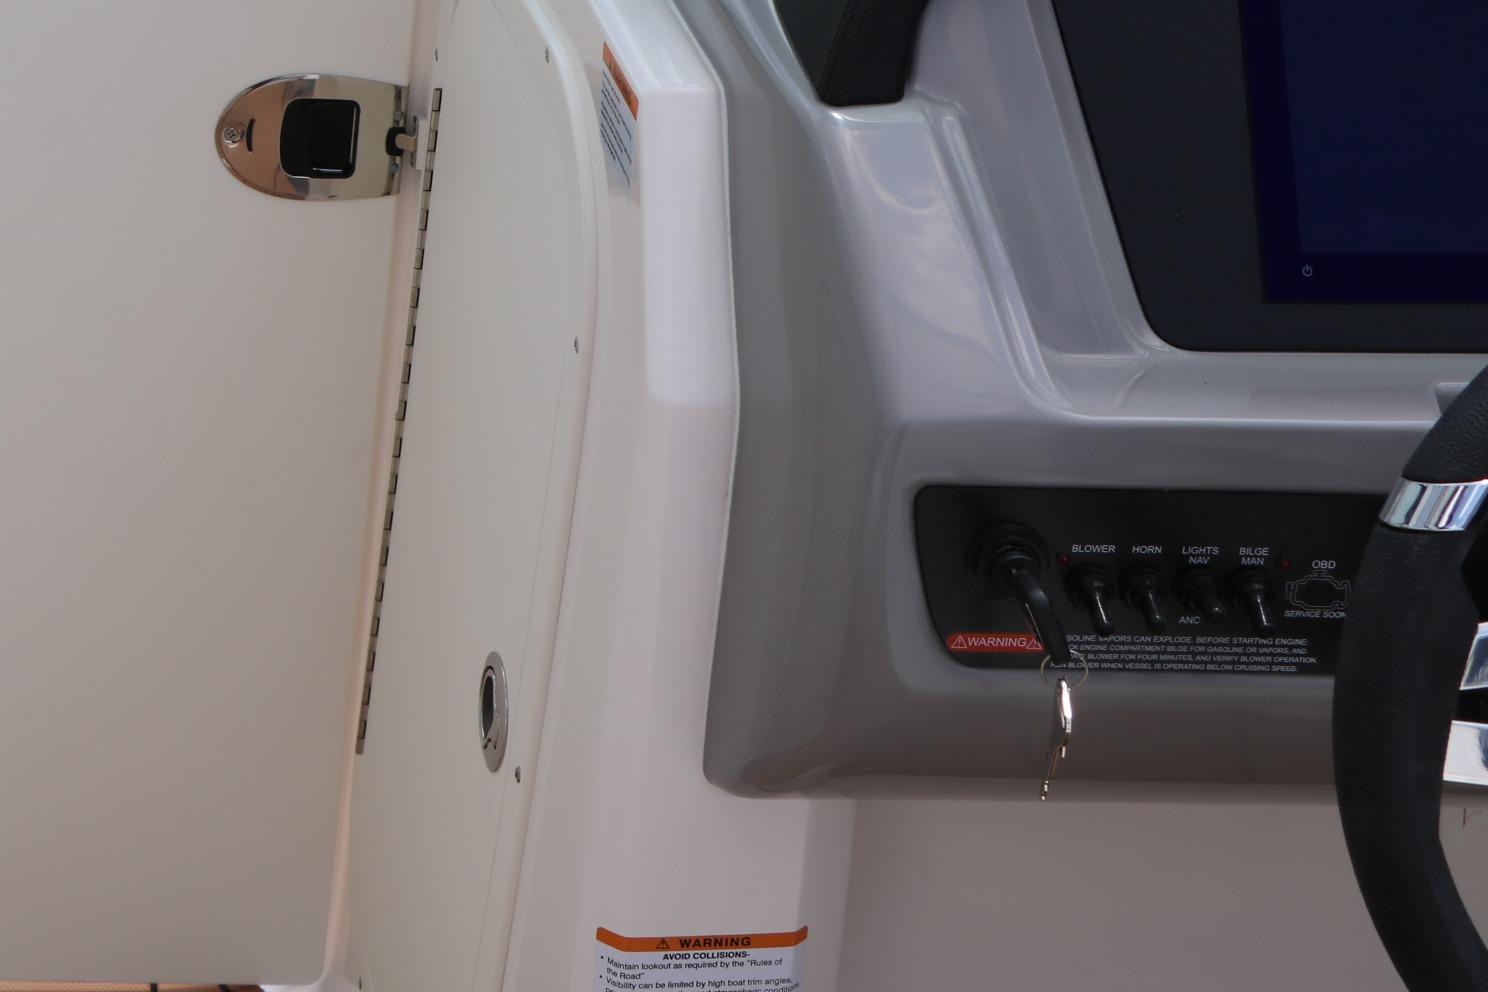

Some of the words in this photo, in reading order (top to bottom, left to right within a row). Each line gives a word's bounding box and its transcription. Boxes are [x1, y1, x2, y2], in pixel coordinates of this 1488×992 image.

[1072, 545, 1116, 553] BLOWER
[1132, 545, 1162, 554] HORN
[1182, 546, 1219, 555] LIGHTS
[1239, 547, 1269, 556] BILGE
[1189, 556, 1210, 565] NAV
[1242, 557, 1264, 565] MAN
[1312, 560, 1335, 569] OBD
[1284, 610, 1321, 618] SERVICE
[1179, 616, 1200, 624] ANC
[968, 637, 1027, 647] WARNING
[1153, 636, 1193, 644] EXPLODE.
[680, 937, 751, 948] WARNING
[663, 952, 690, 961] AVOID
[607, 958, 639, 970] Maintain
[642, 962, 671, 970] lookout
[685, 961, 718, 970] required
[720, 960, 730, 968] by
[775, 958, 782, 966] of
[607, 967, 618, 978] the
[606, 977, 636, 990] Visibility
[667, 980, 690, 989] limited
[693, 980, 704, 990] by
[708, 979, 726, 988] high
